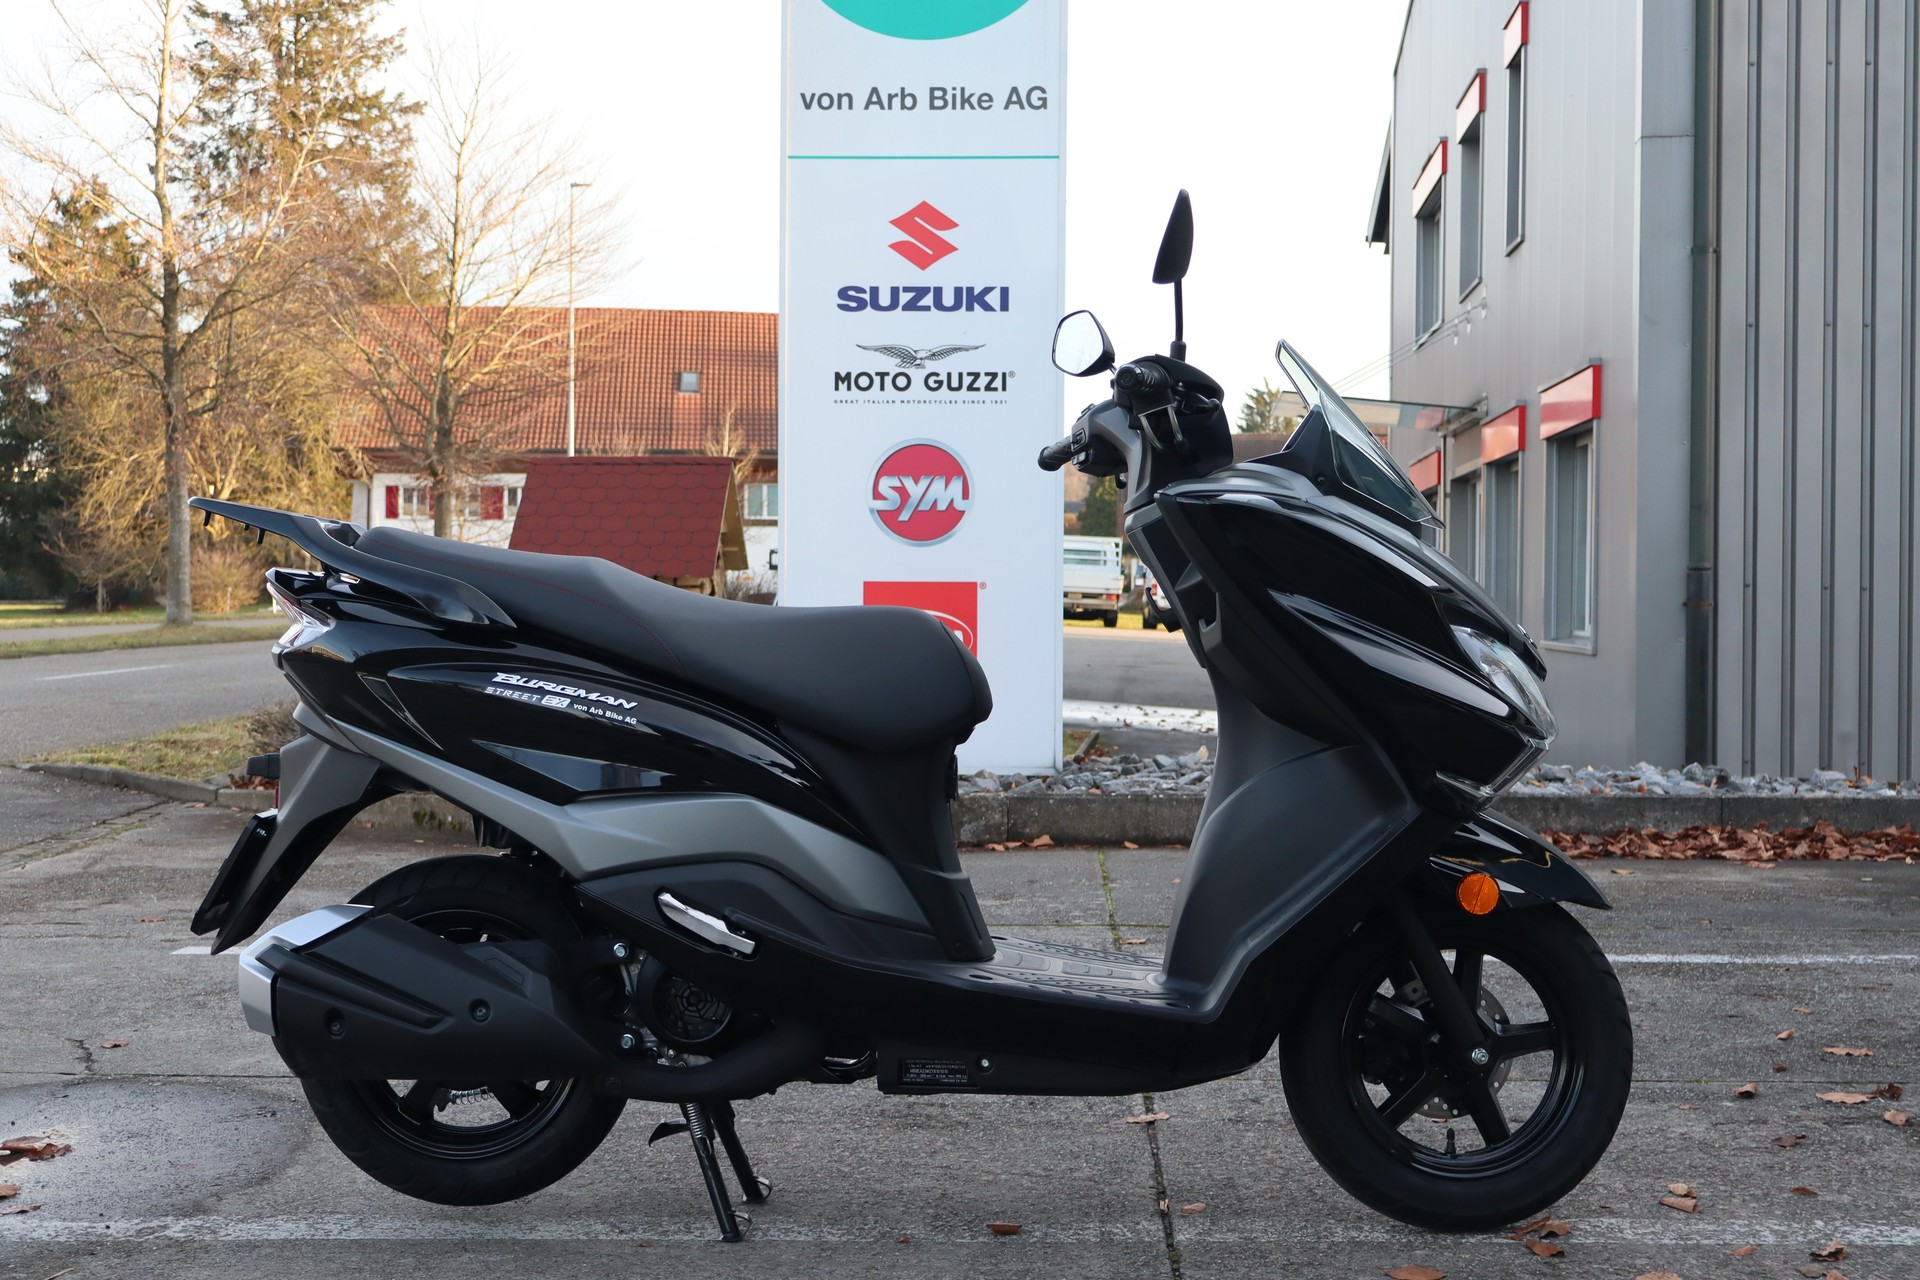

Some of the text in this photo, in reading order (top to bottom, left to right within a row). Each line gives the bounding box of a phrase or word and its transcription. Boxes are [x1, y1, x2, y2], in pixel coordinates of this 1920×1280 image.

[800, 86, 1048, 111] von Arb Bike AG
[836, 285, 1010, 312] SUZUKI
[834, 371, 912, 392] MOTO
[871, 475, 970, 521] SYM
[484, 686, 541, 702] STREET
[491, 672, 638, 710] BURGMAN
[573, 702, 638, 725] von Arb Bike AG
